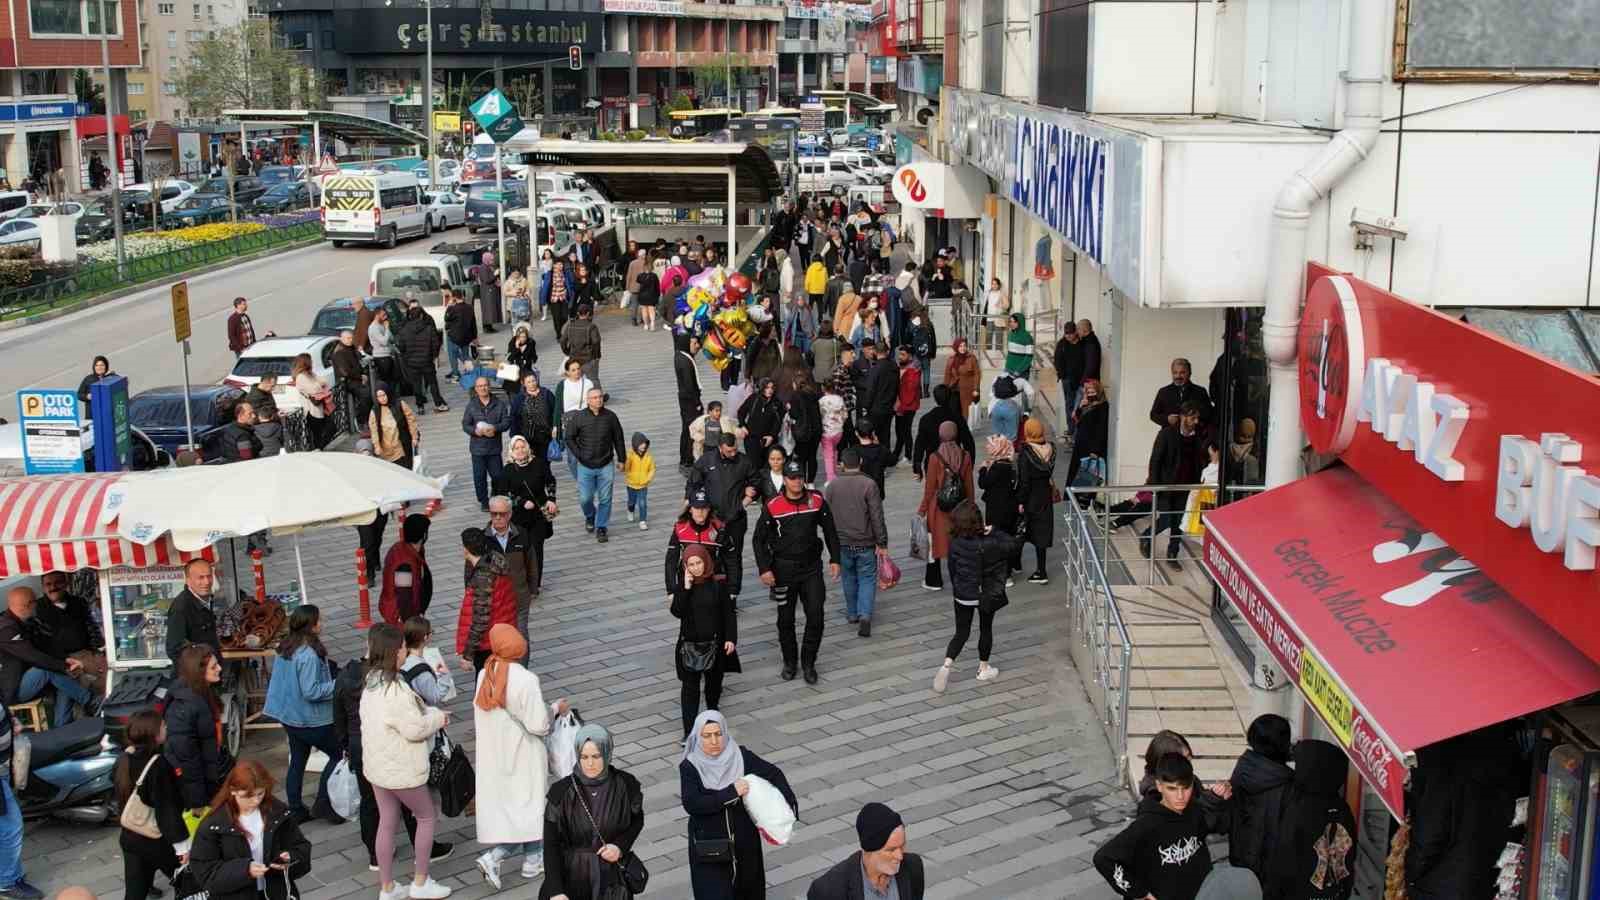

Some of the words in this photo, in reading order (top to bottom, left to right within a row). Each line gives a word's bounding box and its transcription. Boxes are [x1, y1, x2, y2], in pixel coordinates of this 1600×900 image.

[44, 394, 75, 407] OTO
[45, 406, 76, 417] PARK
[1357, 358, 1470, 481] AYAZ
[1247, 589, 1258, 617] VE
[1255, 599, 1275, 644] SATIŞ
[1274, 538, 1345, 594] Gerçek
[1320, 588, 1396, 654] Mucize
